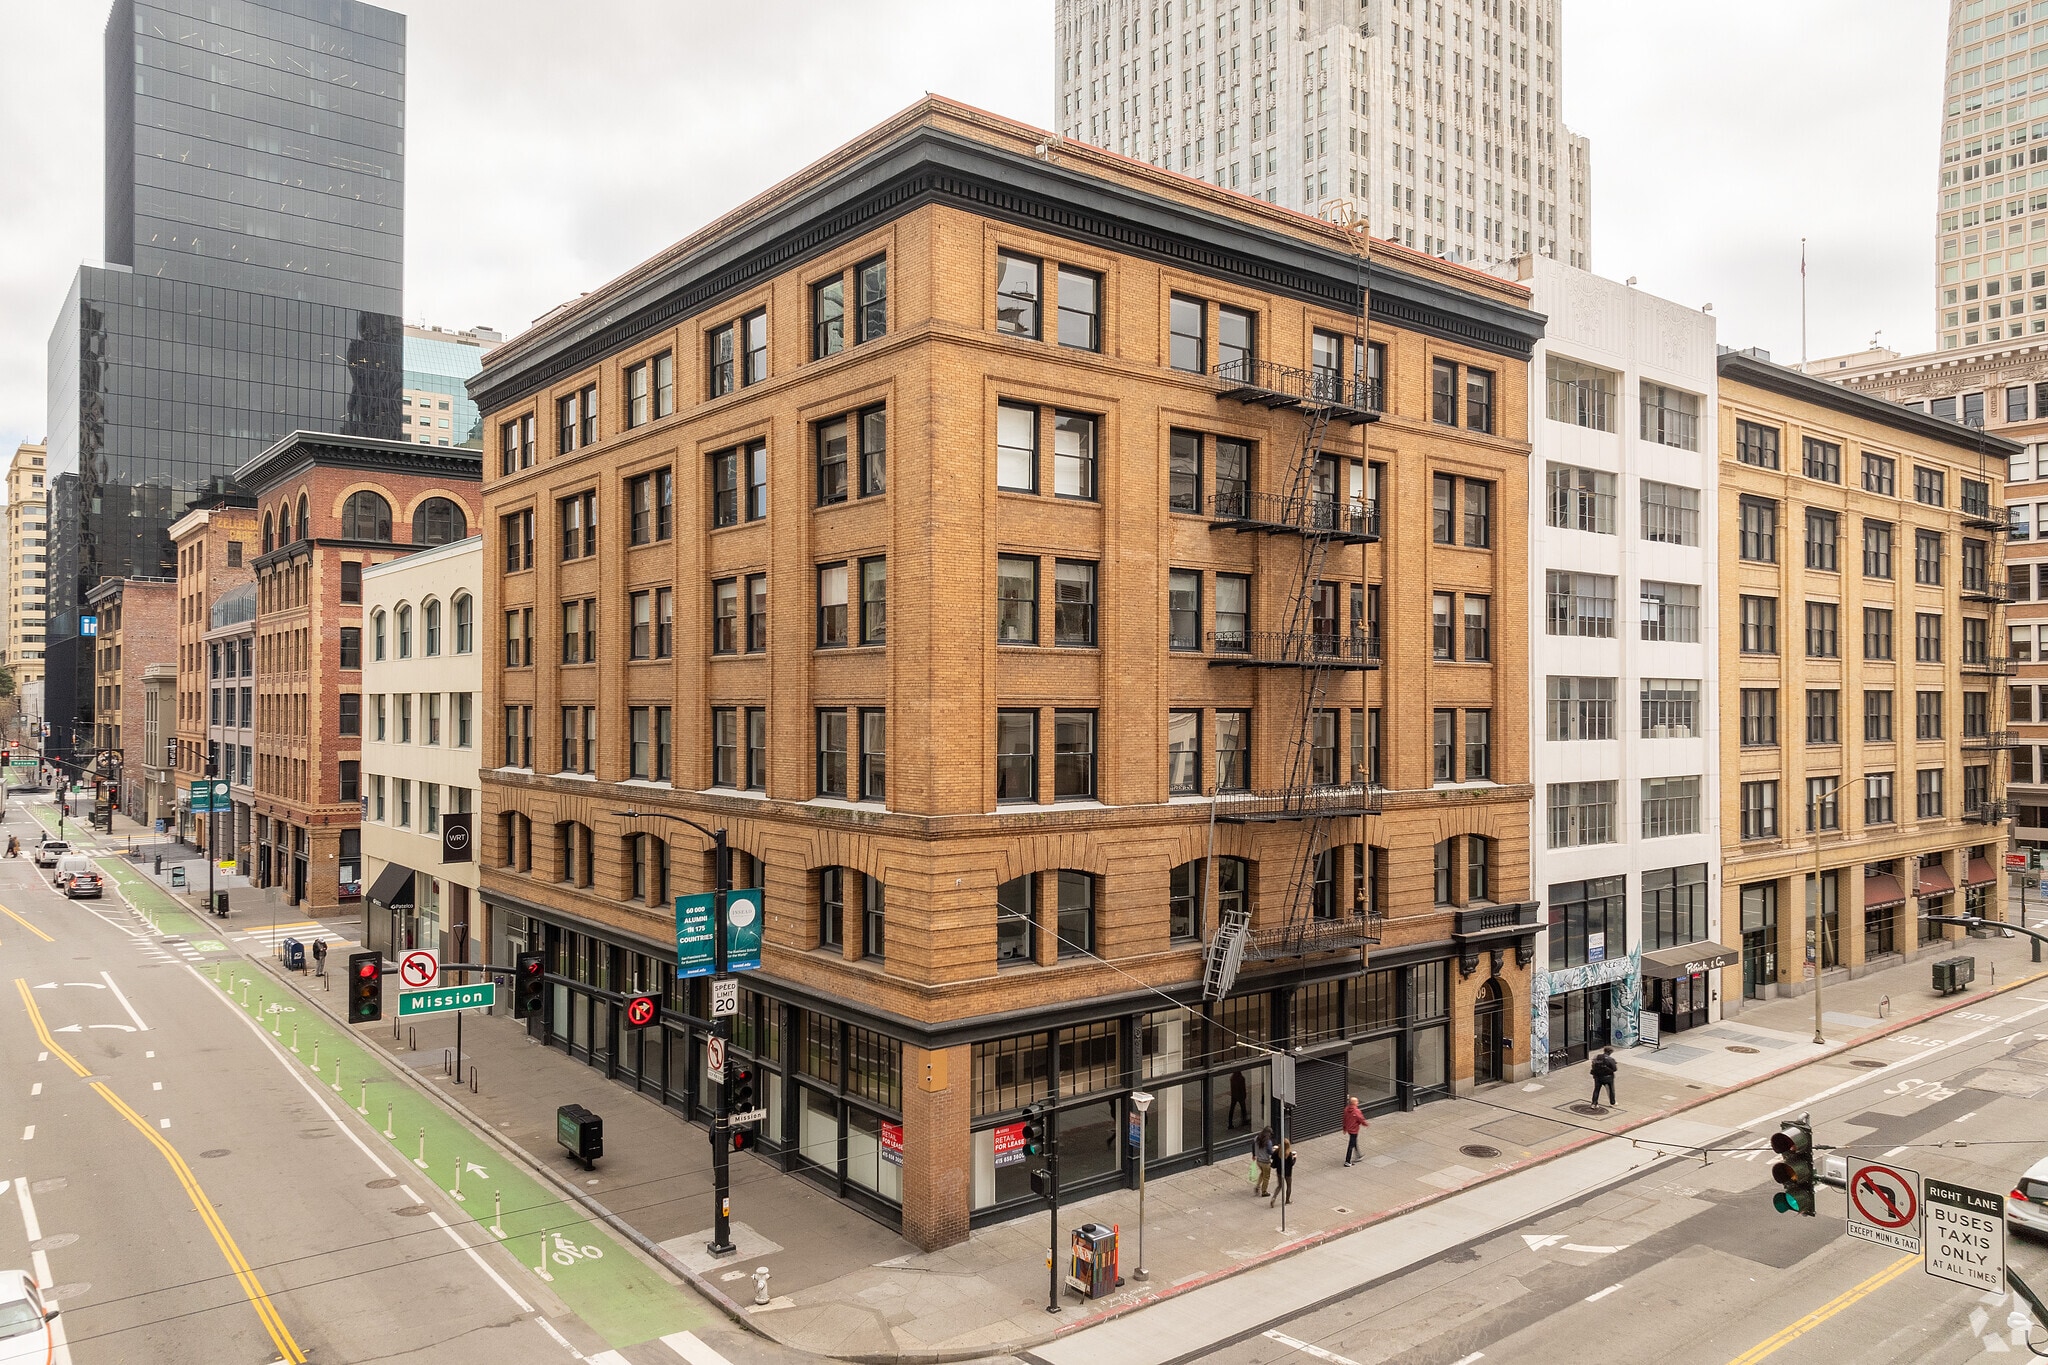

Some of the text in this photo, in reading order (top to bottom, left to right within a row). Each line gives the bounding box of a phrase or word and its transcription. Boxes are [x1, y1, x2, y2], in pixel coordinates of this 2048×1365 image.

[449, 833, 465, 842] WRT
[684, 915, 708, 924] ALUMNI
[680, 933, 714, 944] COUNTRIES
[714, 983, 736, 992] SPEED
[411, 991, 483, 1010] Mission
[715, 998, 735, 1012] 20
[1953, 1011, 2002, 1022] BUS
[734, 1112, 762, 1122] Mission
[882, 1130, 897, 1141] RETAIL
[882, 1137, 890, 1146] FOR
[995, 1133, 1016, 1144] RETAIL
[995, 1138, 1025, 1151] FOR LEASE
[1929, 1187, 1998, 1211] RIGHT LANE
[1935, 1208, 1994, 1233] BUSES
[1850, 1224, 1917, 1250] EXCEPT MUNI & TAXI
[1938, 1226, 1990, 1249] TAXIS
[1941, 1245, 1988, 1266] ONLY
[1932, 1259, 1997, 1284] AT ALL TIMES
